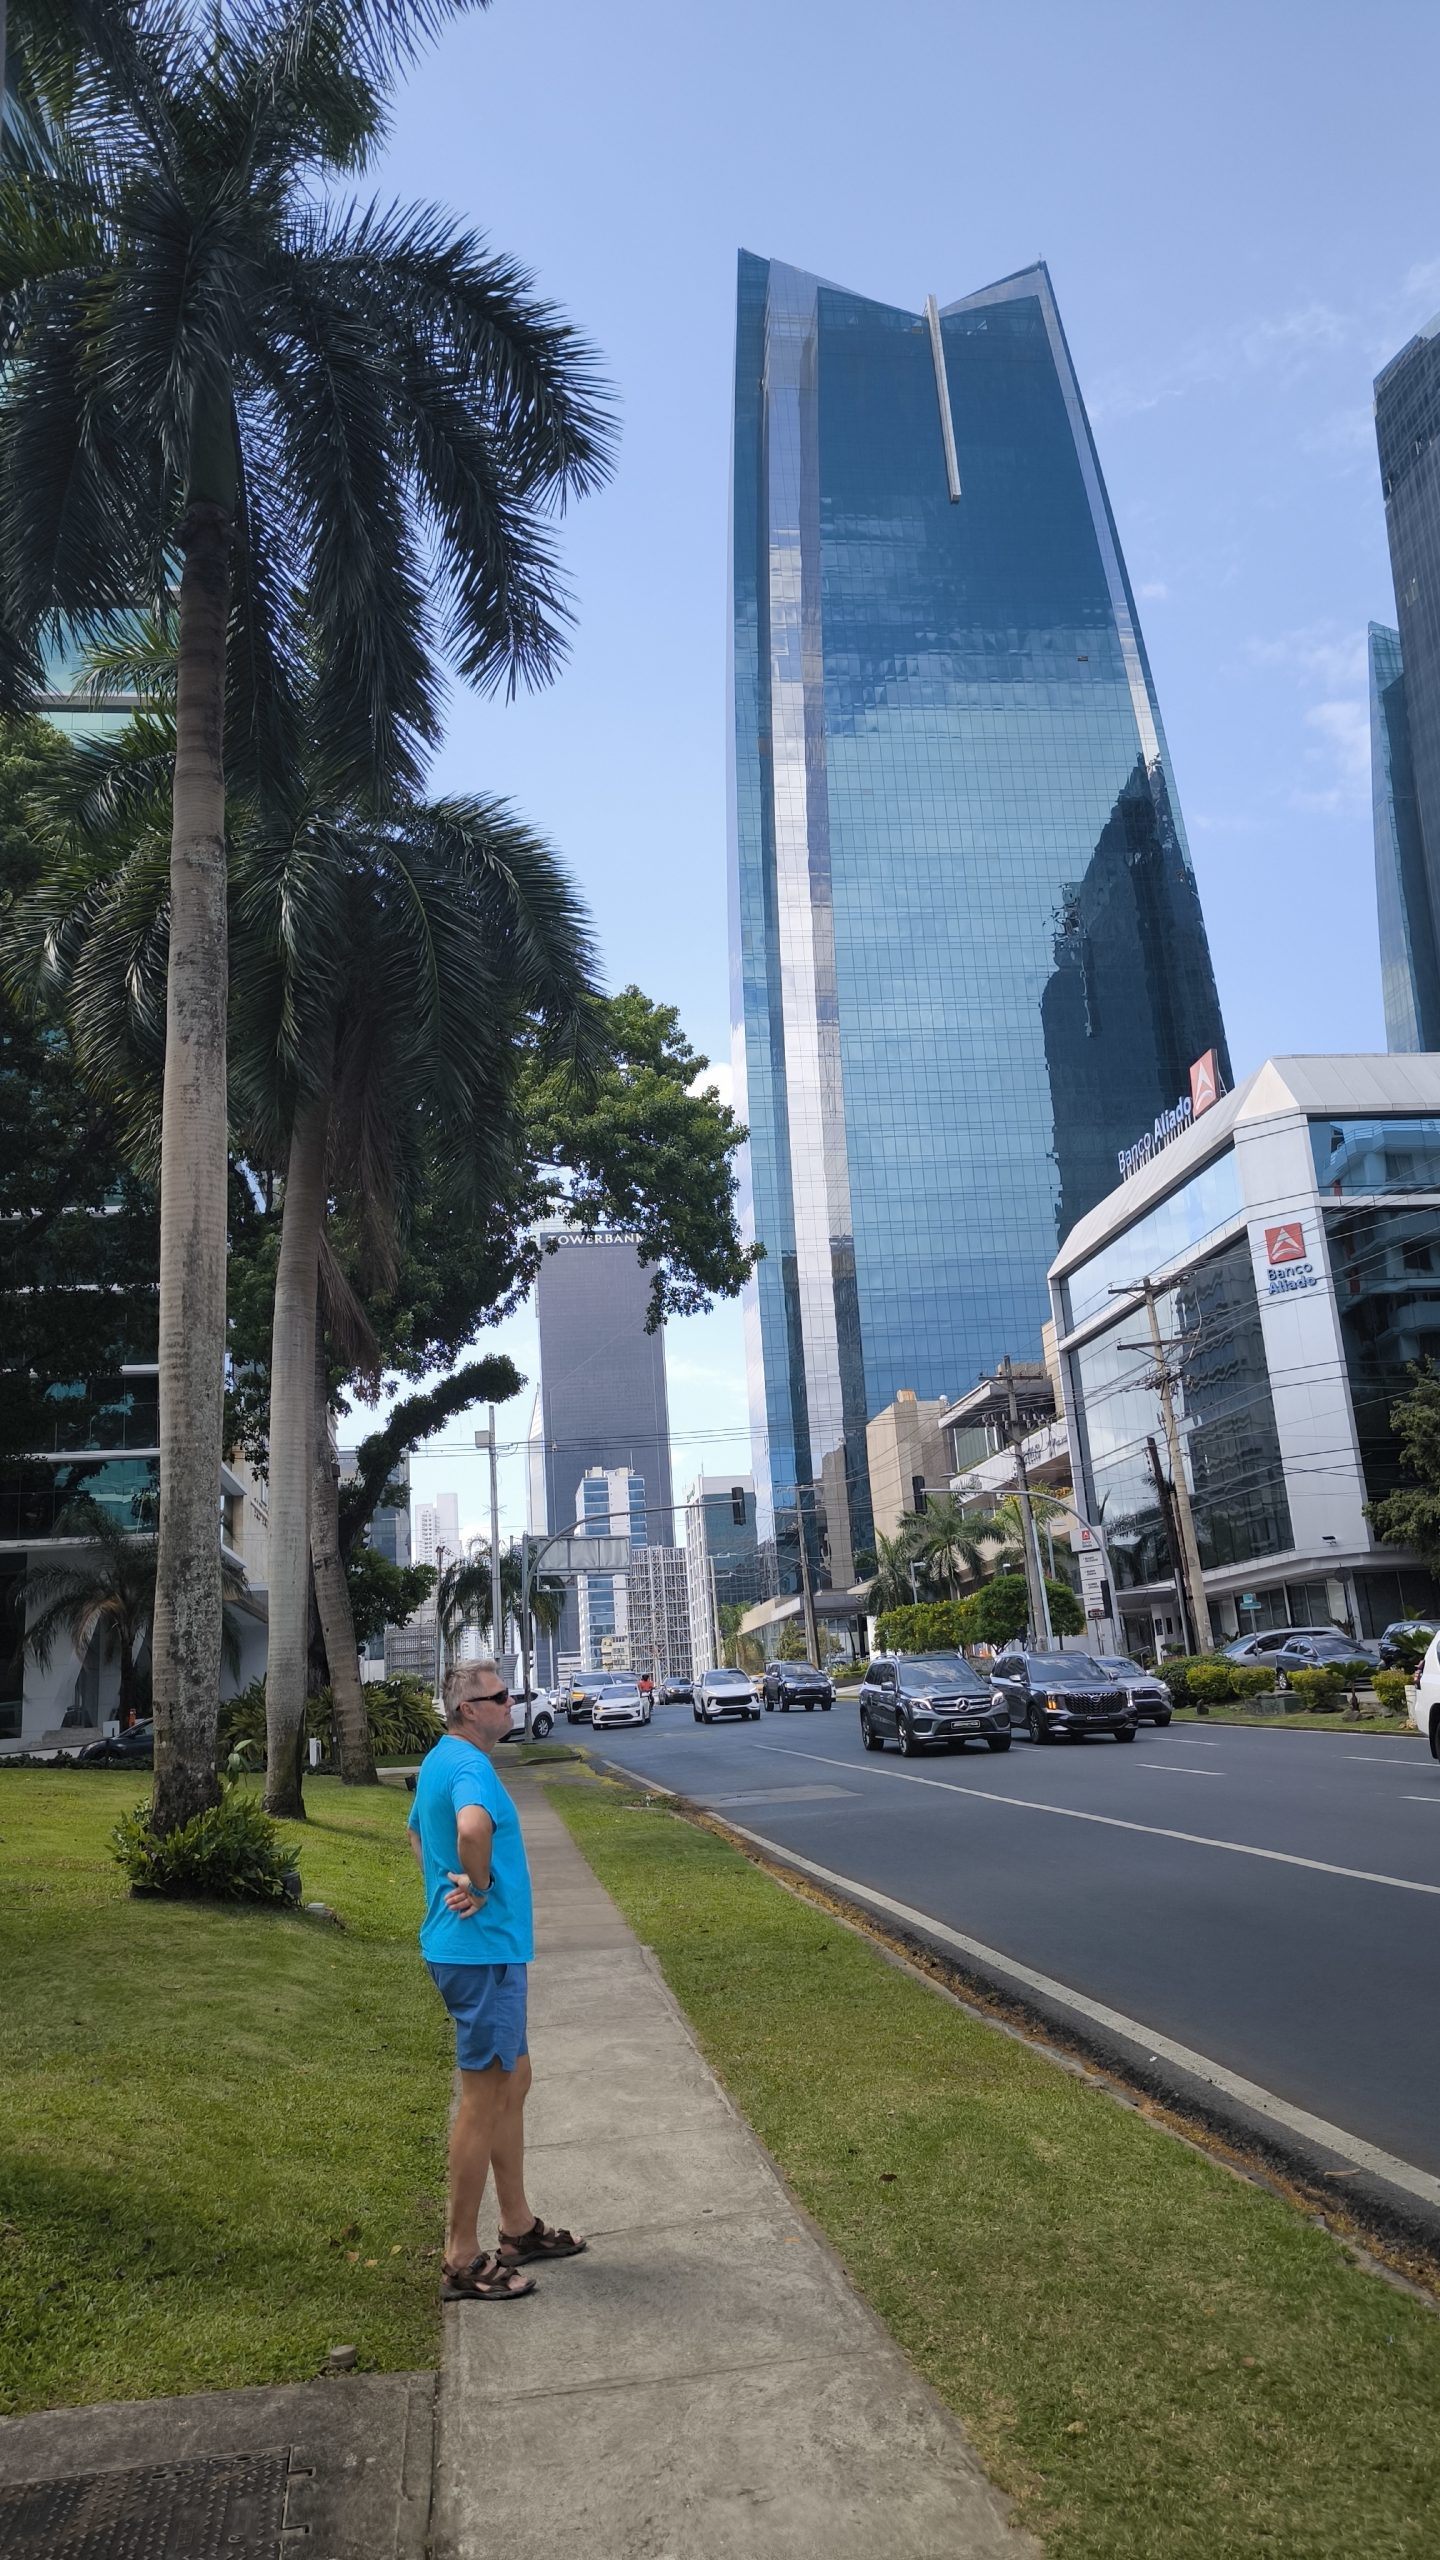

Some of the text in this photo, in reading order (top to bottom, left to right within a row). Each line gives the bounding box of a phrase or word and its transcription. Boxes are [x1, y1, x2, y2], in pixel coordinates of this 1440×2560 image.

[1118, 1096, 1193, 1174] Banco Aliado
[1267, 1263, 1313, 1281] Banco
[1269, 1275, 1317, 1295] Aliado
